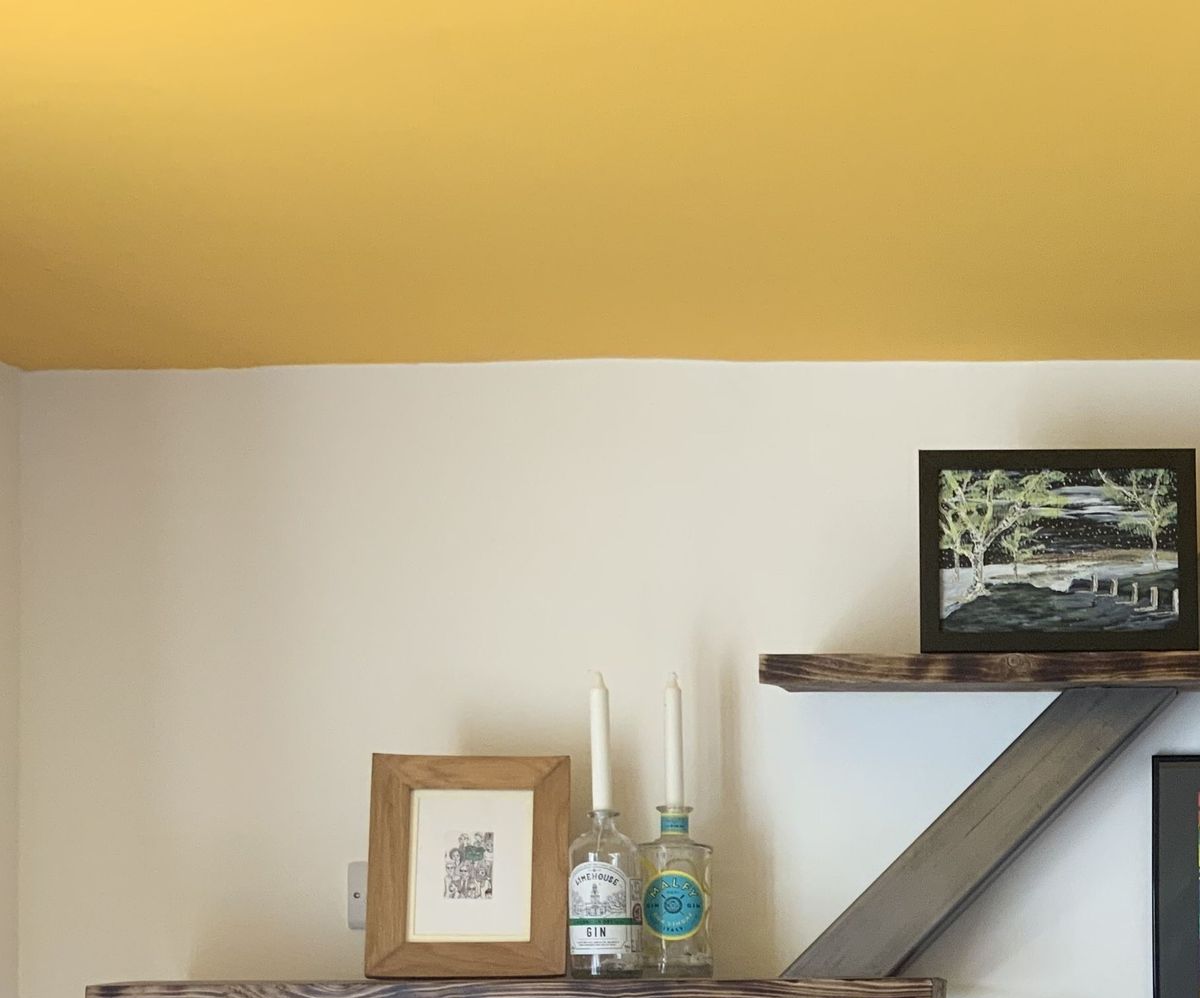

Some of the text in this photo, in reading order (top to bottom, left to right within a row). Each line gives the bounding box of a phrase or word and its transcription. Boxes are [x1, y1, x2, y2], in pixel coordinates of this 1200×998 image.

[575, 873, 620, 886] LIMEHOUSE
[650, 878, 700, 898] MALFY
[586, 926, 607, 938] GIN
